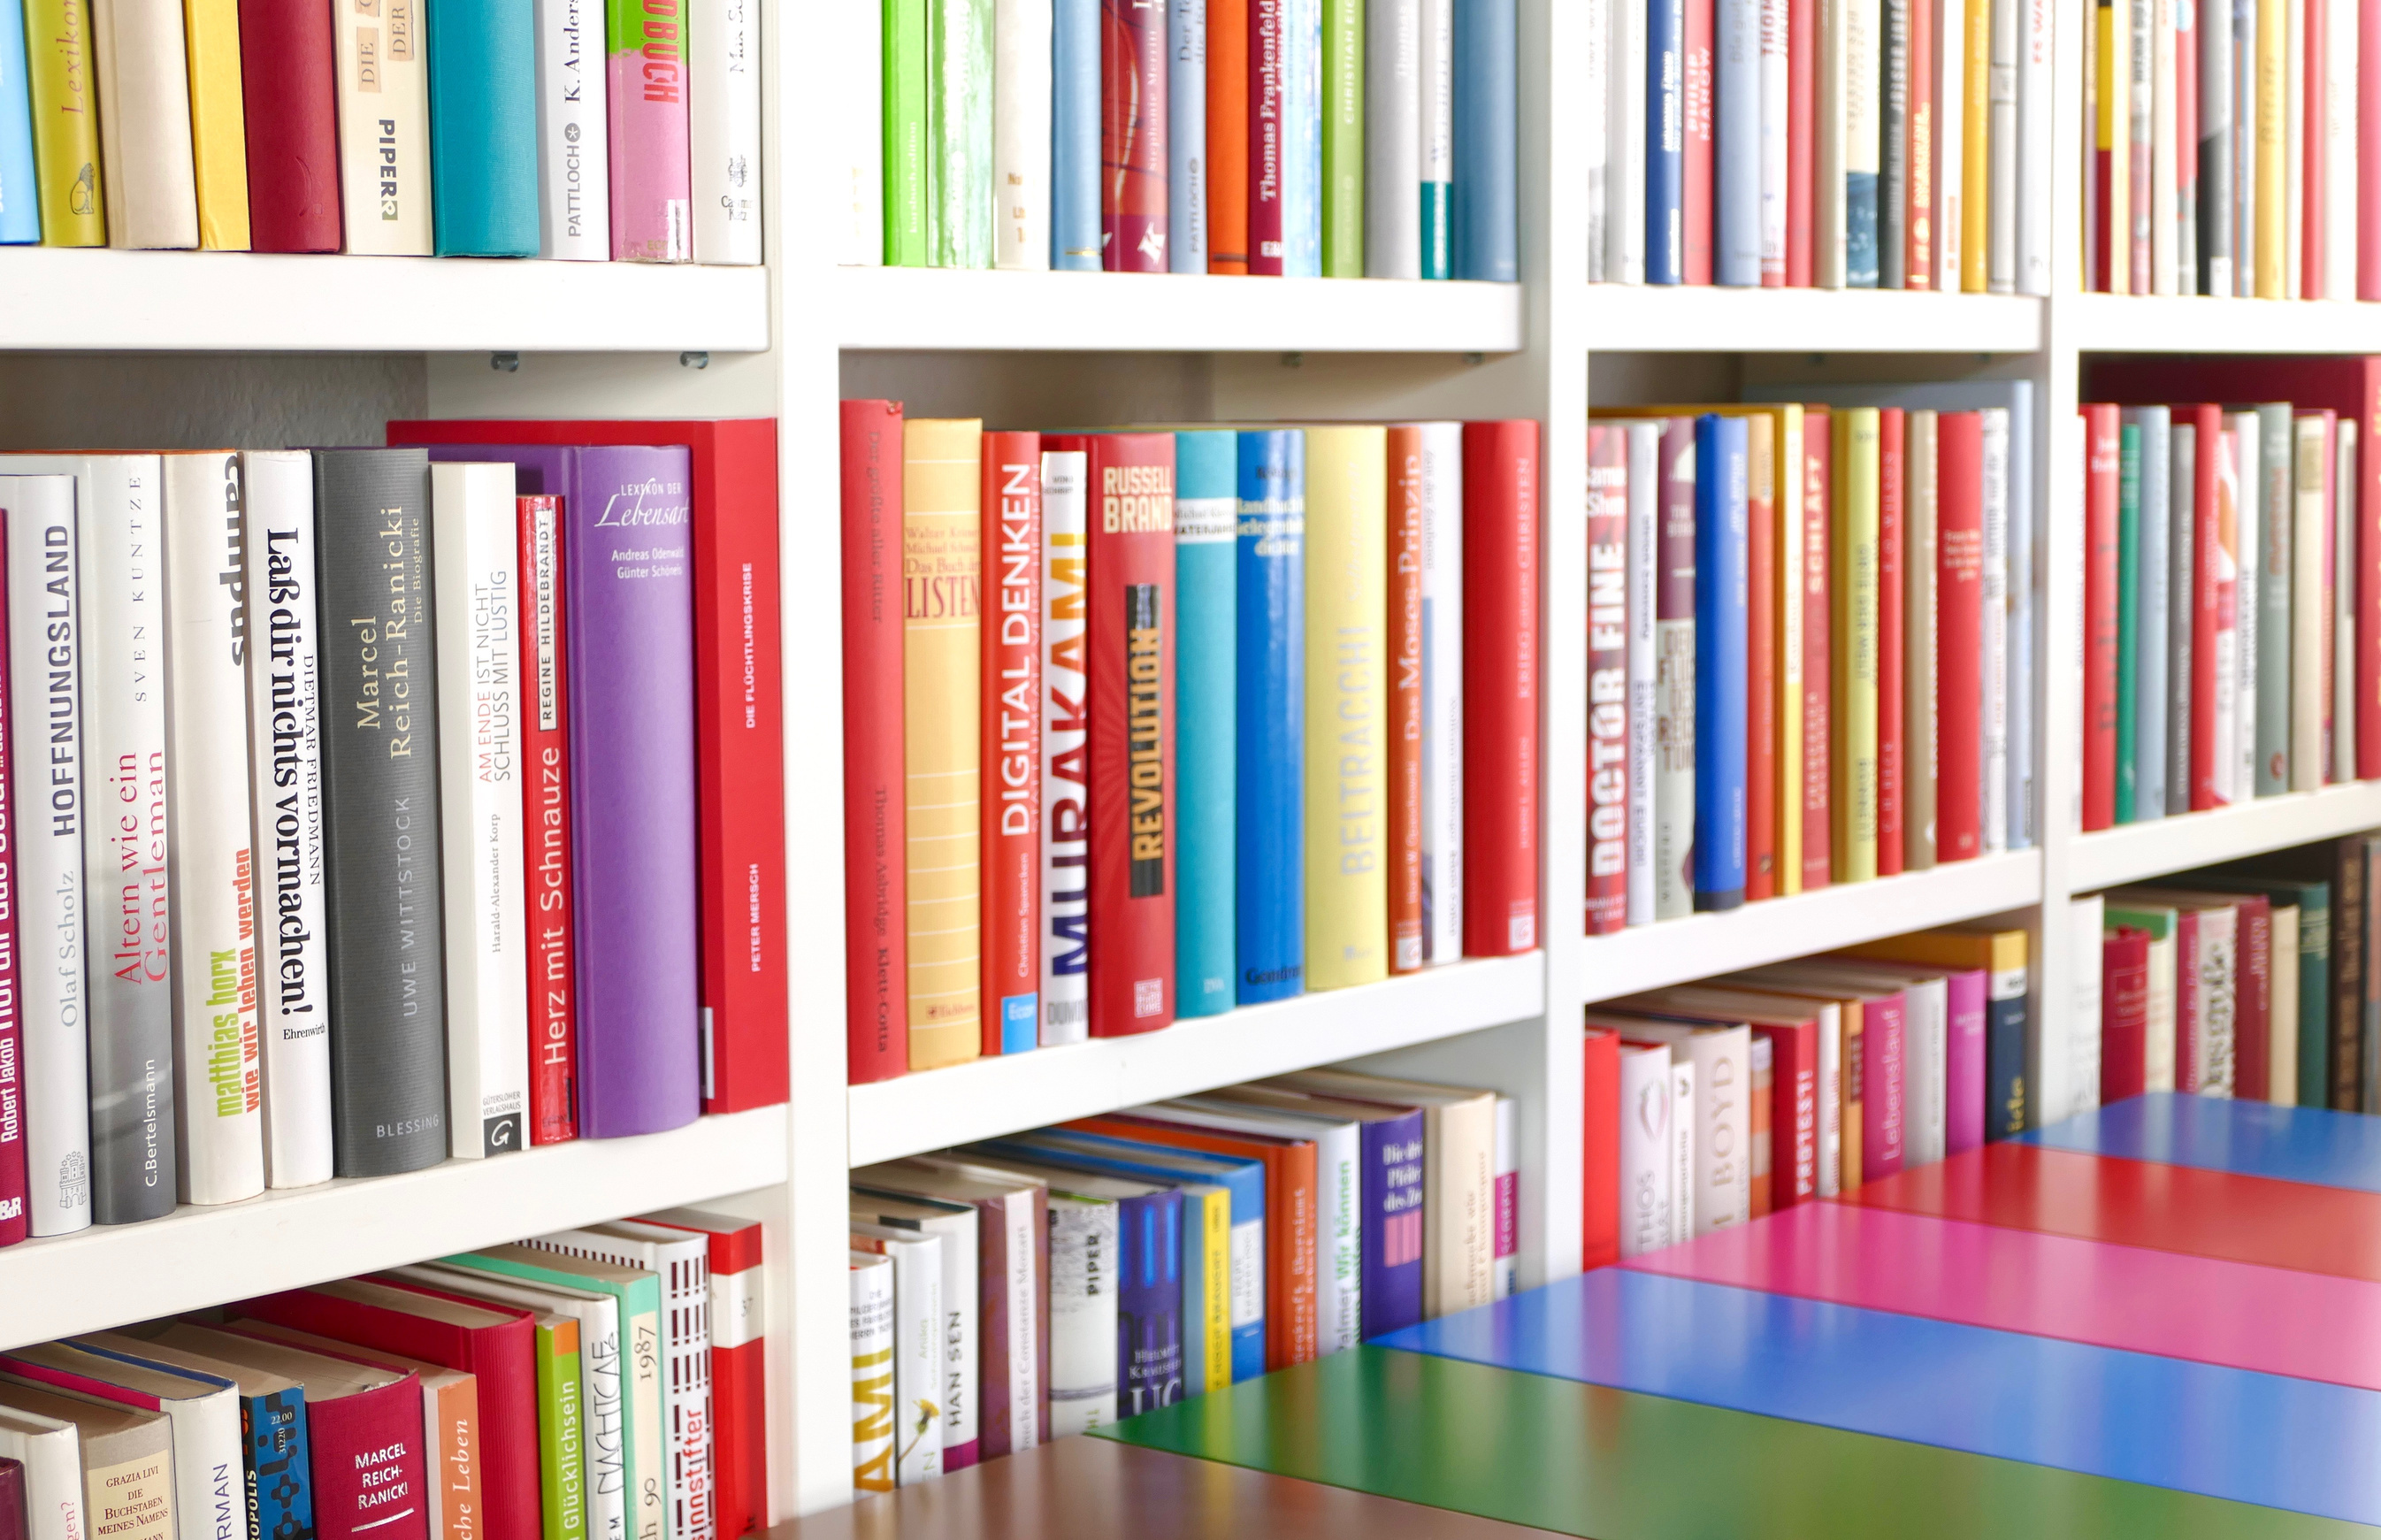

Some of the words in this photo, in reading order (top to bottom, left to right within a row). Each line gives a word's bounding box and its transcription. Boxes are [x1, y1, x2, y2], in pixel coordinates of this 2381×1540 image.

[360, 42, 375, 85] DIE
[392, 6, 407, 55] DER
[1178, 26, 1193, 63] Der
[564, 79, 581, 103] K.
[1344, 30, 1355, 125] CHRISTIAN
[1687, 53, 1699, 132] PHILIP
[1699, 47, 1711, 142] MANOW
[379, 119, 397, 197] PIPER
[568, 143, 581, 237] PATTLOCH
[1259, 123, 1276, 202] Thomas
[868, 431, 881, 463] Der
[1103, 465, 1172, 495] RUSSELL
[593, 478, 690, 528] Lebensart
[621, 481, 664, 497] LEXIKON
[666, 480, 683, 495] DER
[1103, 494, 1173, 533] BRAND
[1515, 457, 1531, 569] CHRISTEN
[129, 477, 144, 602] KUNTZE
[219, 455, 245, 666] campus
[267, 527, 301, 605] Laß
[410, 517, 422, 594] Biografie
[611, 547, 650, 563] Andreas
[651, 546, 685, 560] Odenwald
[616, 563, 649, 579] Günter
[870, 528, 884, 569] aller
[906, 557, 932, 574] Das
[1001, 464, 1030, 647] DENKEN
[1397, 455, 1421, 690] Moses-Prinzip
[413, 596, 424, 624] Die
[491, 571, 507, 641] LUSTIG
[539, 518, 551, 646] HILDEBRANDT
[1590, 543, 1625, 652] FINE
[268, 608, 302, 667] dir
[379, 506, 411, 759] Reich-Ranicki
[475, 583, 489, 649] NICHT
[741, 562, 755, 703] FLÜCHTLINGSKRISE
[45, 525, 75, 837] HOFFNUNGSLAND
[134, 625, 147, 702] SVEN
[351, 616, 380, 730] Marcel
[476, 655, 490, 685] IST
[492, 647, 509, 685] MIT
[540, 655, 553, 721] REGINE
[1516, 631, 1531, 700] KRIEG
[272, 672, 305, 788] nichts
[302, 655, 317, 752] DIETMAR
[477, 691, 491, 747] ENDE
[494, 691, 511, 781] SCHLUSS
[746, 705, 756, 730] DIE
[1404, 696, 1420, 740] Das
[110, 752, 137, 804] ein
[478, 755, 492, 783] AM
[1001, 655, 1030, 836] DIGITAL
[1051, 532, 1088, 977] MURAKAMI
[1129, 628, 1163, 862] REVOLUTION
[1337, 626, 1374, 876] BELTRACCHI
[1590, 667, 1626, 877] DOCTOR
[111, 812, 139, 874] wie
[306, 756, 321, 885] FRIEDMANN
[489, 813, 501, 842] Korp
[539, 746, 563, 912] Schnauze
[875, 787, 888, 858] Thomas
[142, 749, 168, 983] Gentleman
[232, 847, 253, 940] werden
[395, 796, 416, 946] WITTSTOCK
[748, 863, 761, 923] MERSCH
[57, 870, 77, 961] Scholz
[275, 791, 314, 1016] vormachen!
[490, 846, 501, 954] Harald-Alexander
[114, 885, 142, 985] Altern
[540, 926, 564, 982] mit
[750, 925, 762, 973] PETER
[1018, 917, 1030, 978] Christian
[60, 967, 78, 1028] Olaf
[206, 947, 238, 1008] horx
[237, 946, 256, 1015] leben
[402, 959, 417, 1017] UWE
[239, 1021, 259, 1064] wir
[282, 1023, 325, 1041] Ehrenwirth
[544, 990, 567, 1066] Herz
[0, 1037, 16, 1088] Jakob
[209, 1014, 243, 1117] matthias
[241, 1078, 260, 1113] wie
[1881, 1009, 1902, 1161] Lebenslauf
[1, 1089, 18, 1143] Robert
[144, 1059, 158, 1187] C.Bertelsmann
[376, 1114, 440, 1138] BLESSING
[1711, 1055, 1734, 1188] BOYD
[1336, 1161, 1351, 1238] können
[1087, 1234, 1101, 1296] PIPER
[1336, 1245, 1351, 1281] Wir
[635, 1327, 656, 1380] 1987
[271, 1411, 293, 1425] 22.00
[105, 1472, 142, 1488] GRAZIA
[142, 1466, 159, 1479] LIVI
[355, 1442, 407, 1469] MARCEL
[362, 1465, 403, 1489] REICH-
[451, 1418, 471, 1492] Leben
[561, 1381, 579, 1529] Glücklichsein
[104, 1495, 164, 1520] BUCHSTABEN
[127, 1488, 144, 1501] DIE
[213, 1463, 233, 1540] RMAN
[358, 1481, 409, 1510] RANICKI
[644, 1477, 661, 1506] 90
[97, 1521, 135, 1536] MEINES
